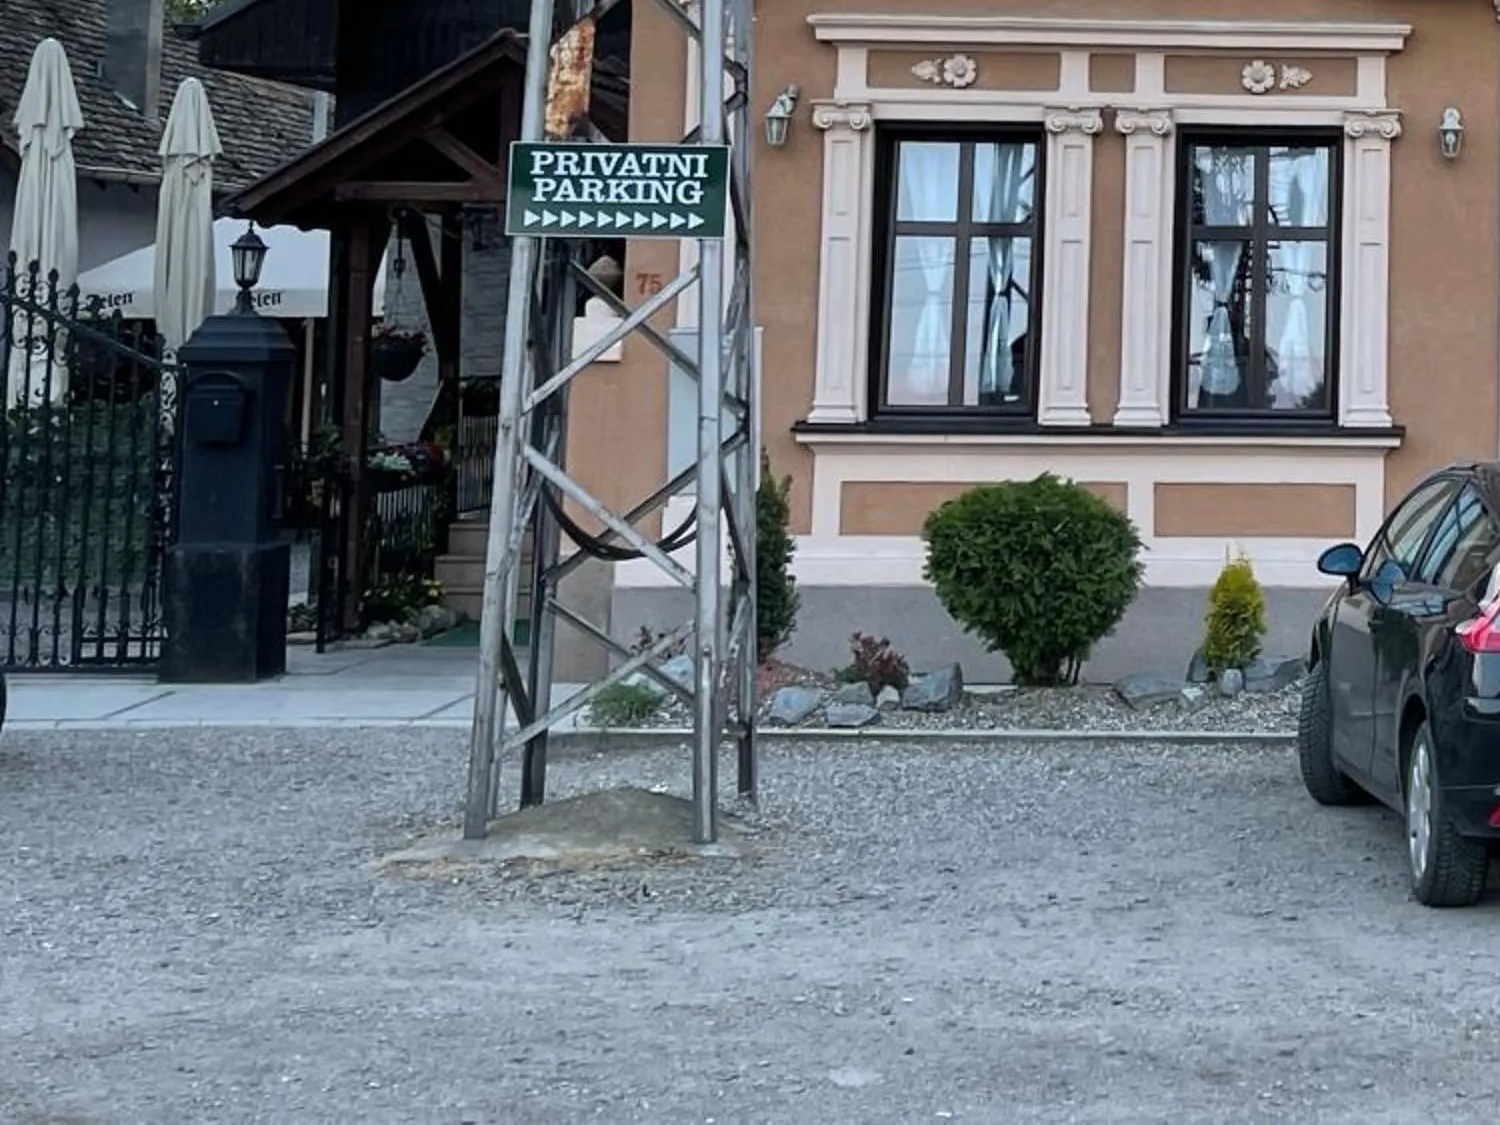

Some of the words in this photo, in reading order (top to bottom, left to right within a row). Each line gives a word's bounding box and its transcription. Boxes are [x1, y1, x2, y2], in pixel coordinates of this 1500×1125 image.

[530, 150, 709, 178] PRIVATNI
[532, 177, 704, 205] PARKING
[636, 273, 662, 295] 75
